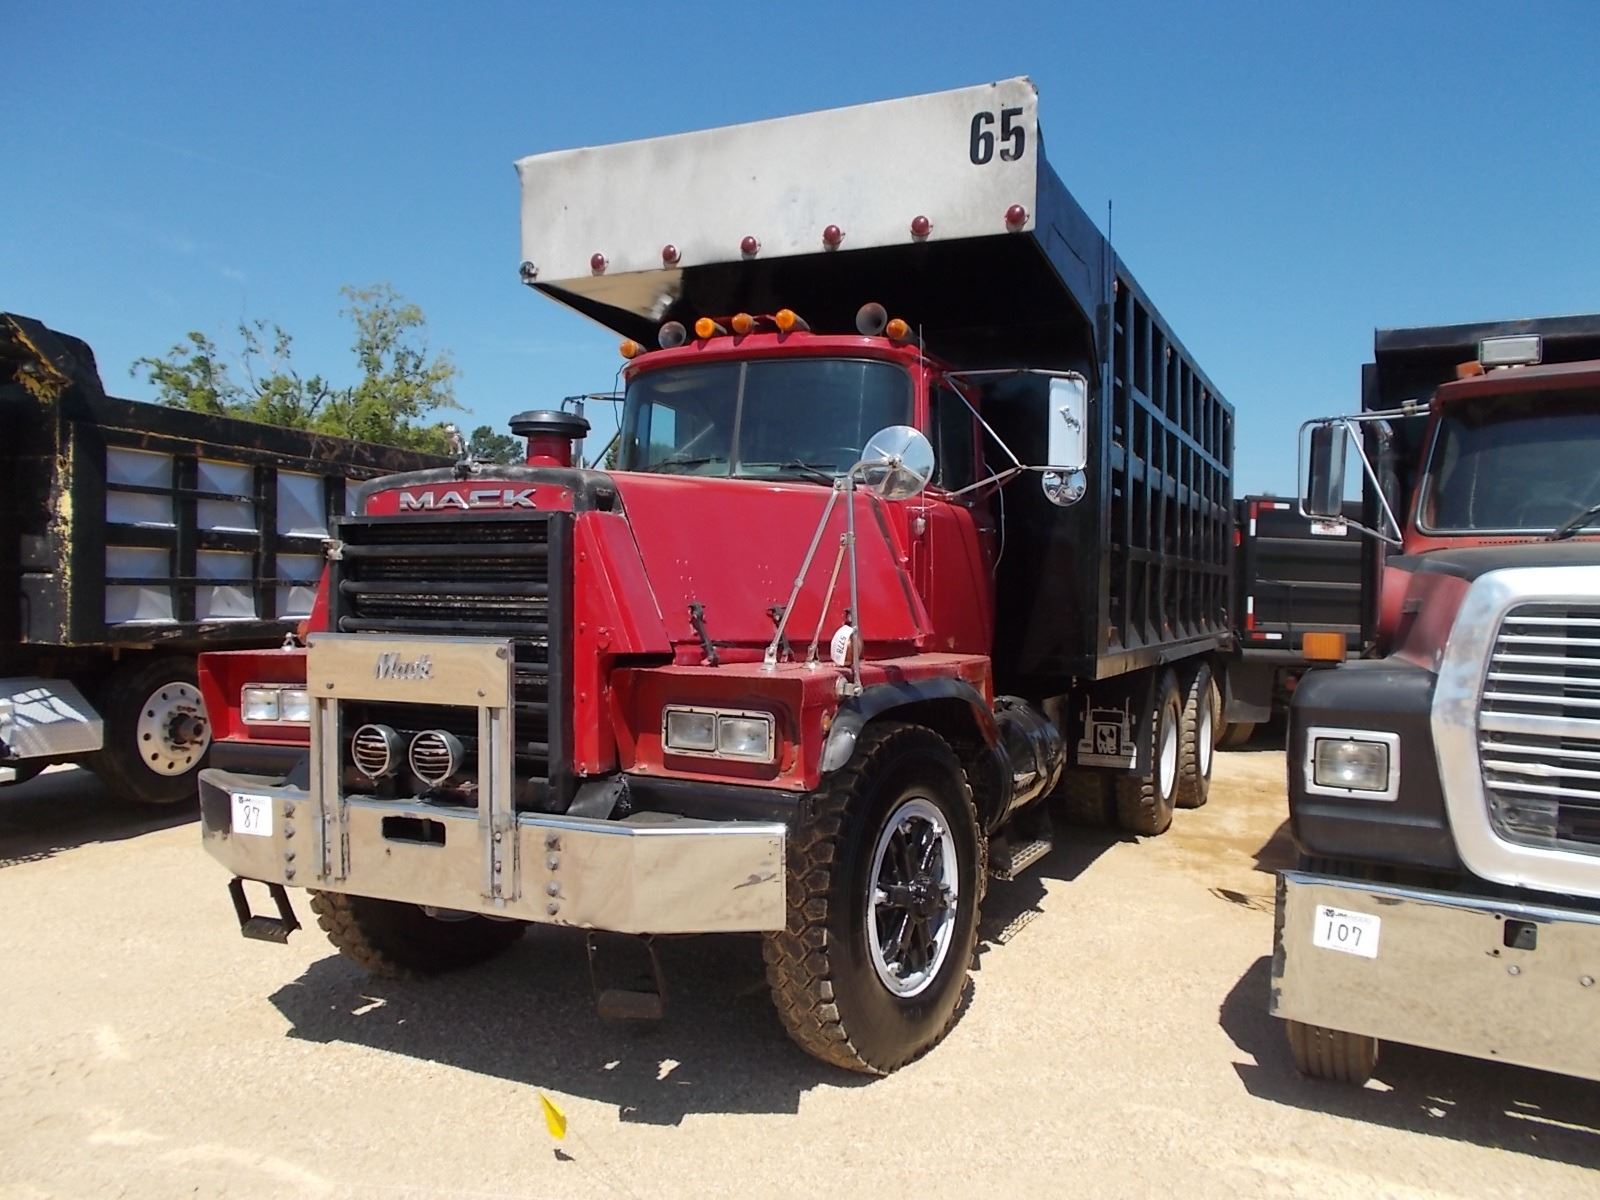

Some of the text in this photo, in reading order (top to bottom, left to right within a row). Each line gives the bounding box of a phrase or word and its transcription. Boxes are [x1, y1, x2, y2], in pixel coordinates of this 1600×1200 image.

[969, 107, 1026, 166] 65
[399, 488, 537, 511] MACK
[243, 804, 260, 829] 87
[1327, 921, 1362, 947] 107
